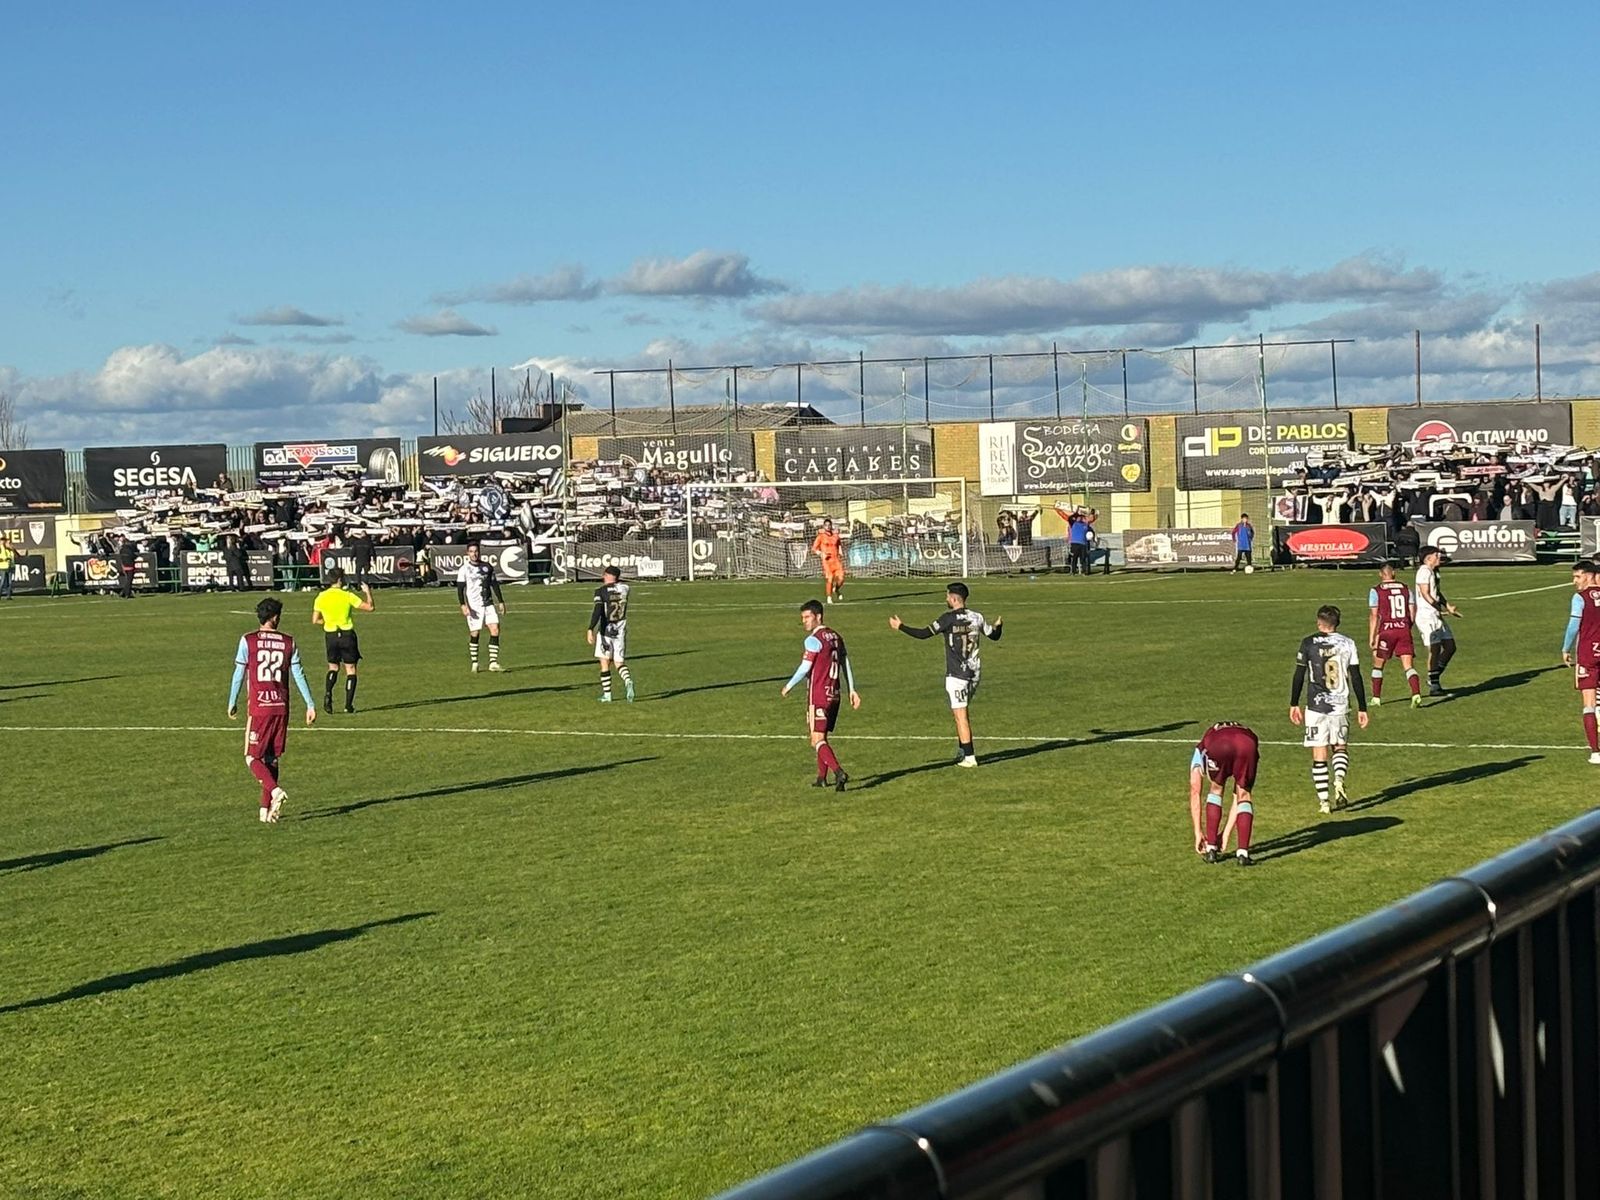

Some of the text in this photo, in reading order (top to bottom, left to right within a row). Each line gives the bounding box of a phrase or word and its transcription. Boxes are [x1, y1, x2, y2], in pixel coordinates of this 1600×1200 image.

[1043, 424, 1100, 436] BODEGA
[1248, 423, 1347, 442] DE PABLOS
[1462, 429, 1548, 443] OCTAVIANO
[643, 440, 675, 448] venta
[785, 444, 920, 455] RESTAURANE
[1022, 426, 1113, 457] Severino
[469, 445, 562, 463] SIGUERO
[642, 443, 733, 470] Magullo
[785, 455, 920, 474] CASARES
[1028, 453, 1101, 478] Sanz
[113, 466, 197, 487] SEGESA
[1171, 532, 1233, 542] Hotel Avenida
[1459, 525, 1526, 543] eufón
[1299, 543, 1354, 552] MESTOLAYA
[566, 553, 651, 568] BricoCentro
[1388, 595, 1406, 619] 19
[257, 650, 283, 682] 22
[1325, 660, 1340, 689] 8
